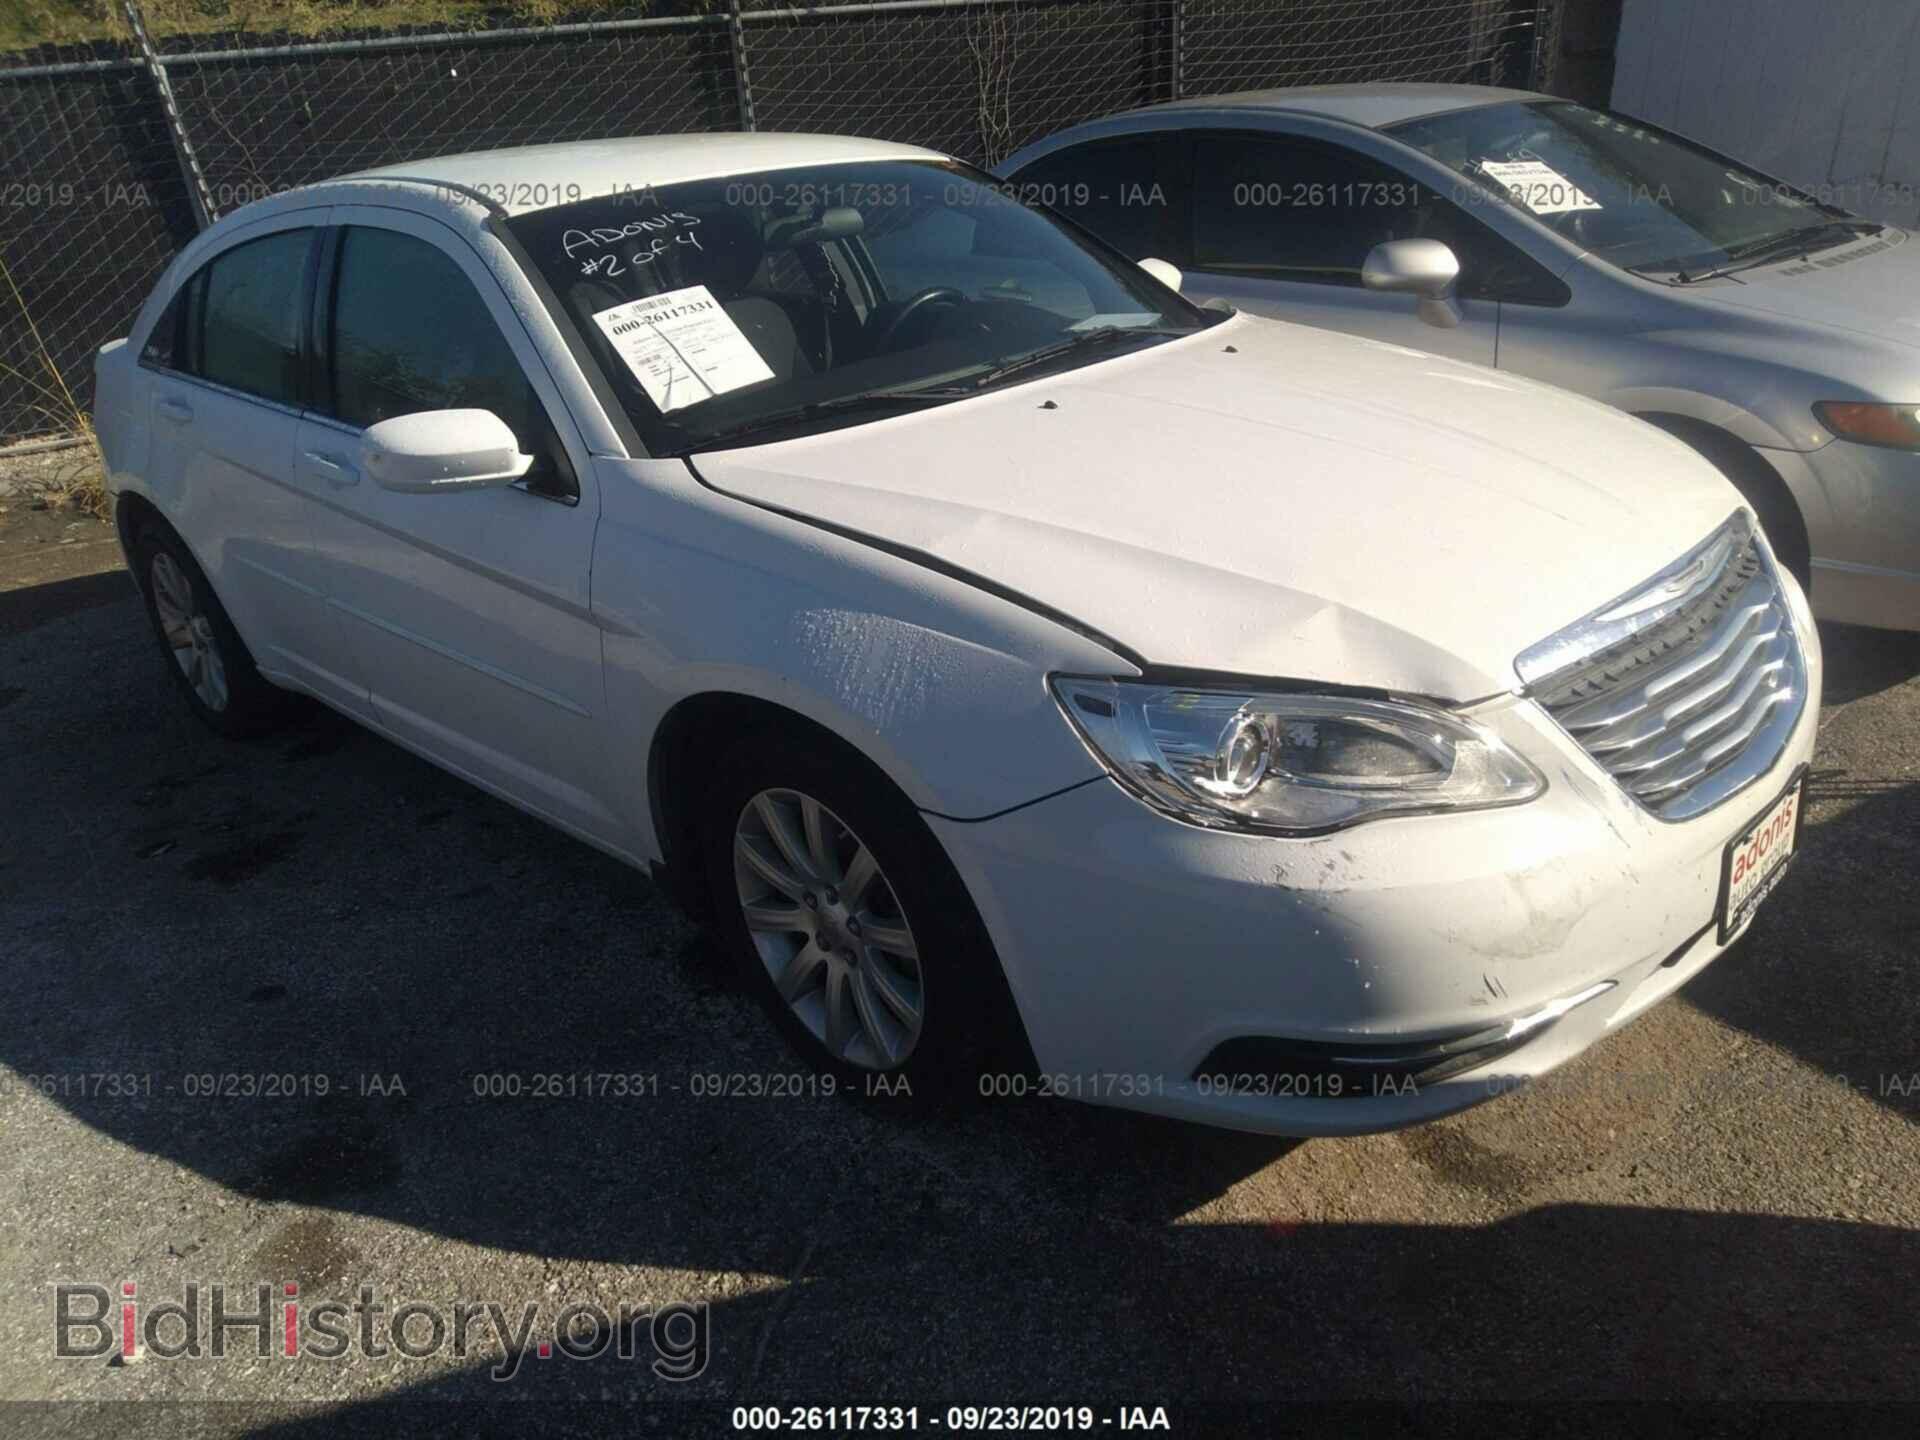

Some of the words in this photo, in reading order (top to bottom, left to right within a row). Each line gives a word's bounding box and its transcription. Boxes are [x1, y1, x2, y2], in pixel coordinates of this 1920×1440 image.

[581, 254, 627, 277] #2
[632, 238, 668, 264] of
[675, 231, 704, 251] 4
[612, 300, 716, 336] 000-26117331
[1733, 798, 1794, 883] adonis
